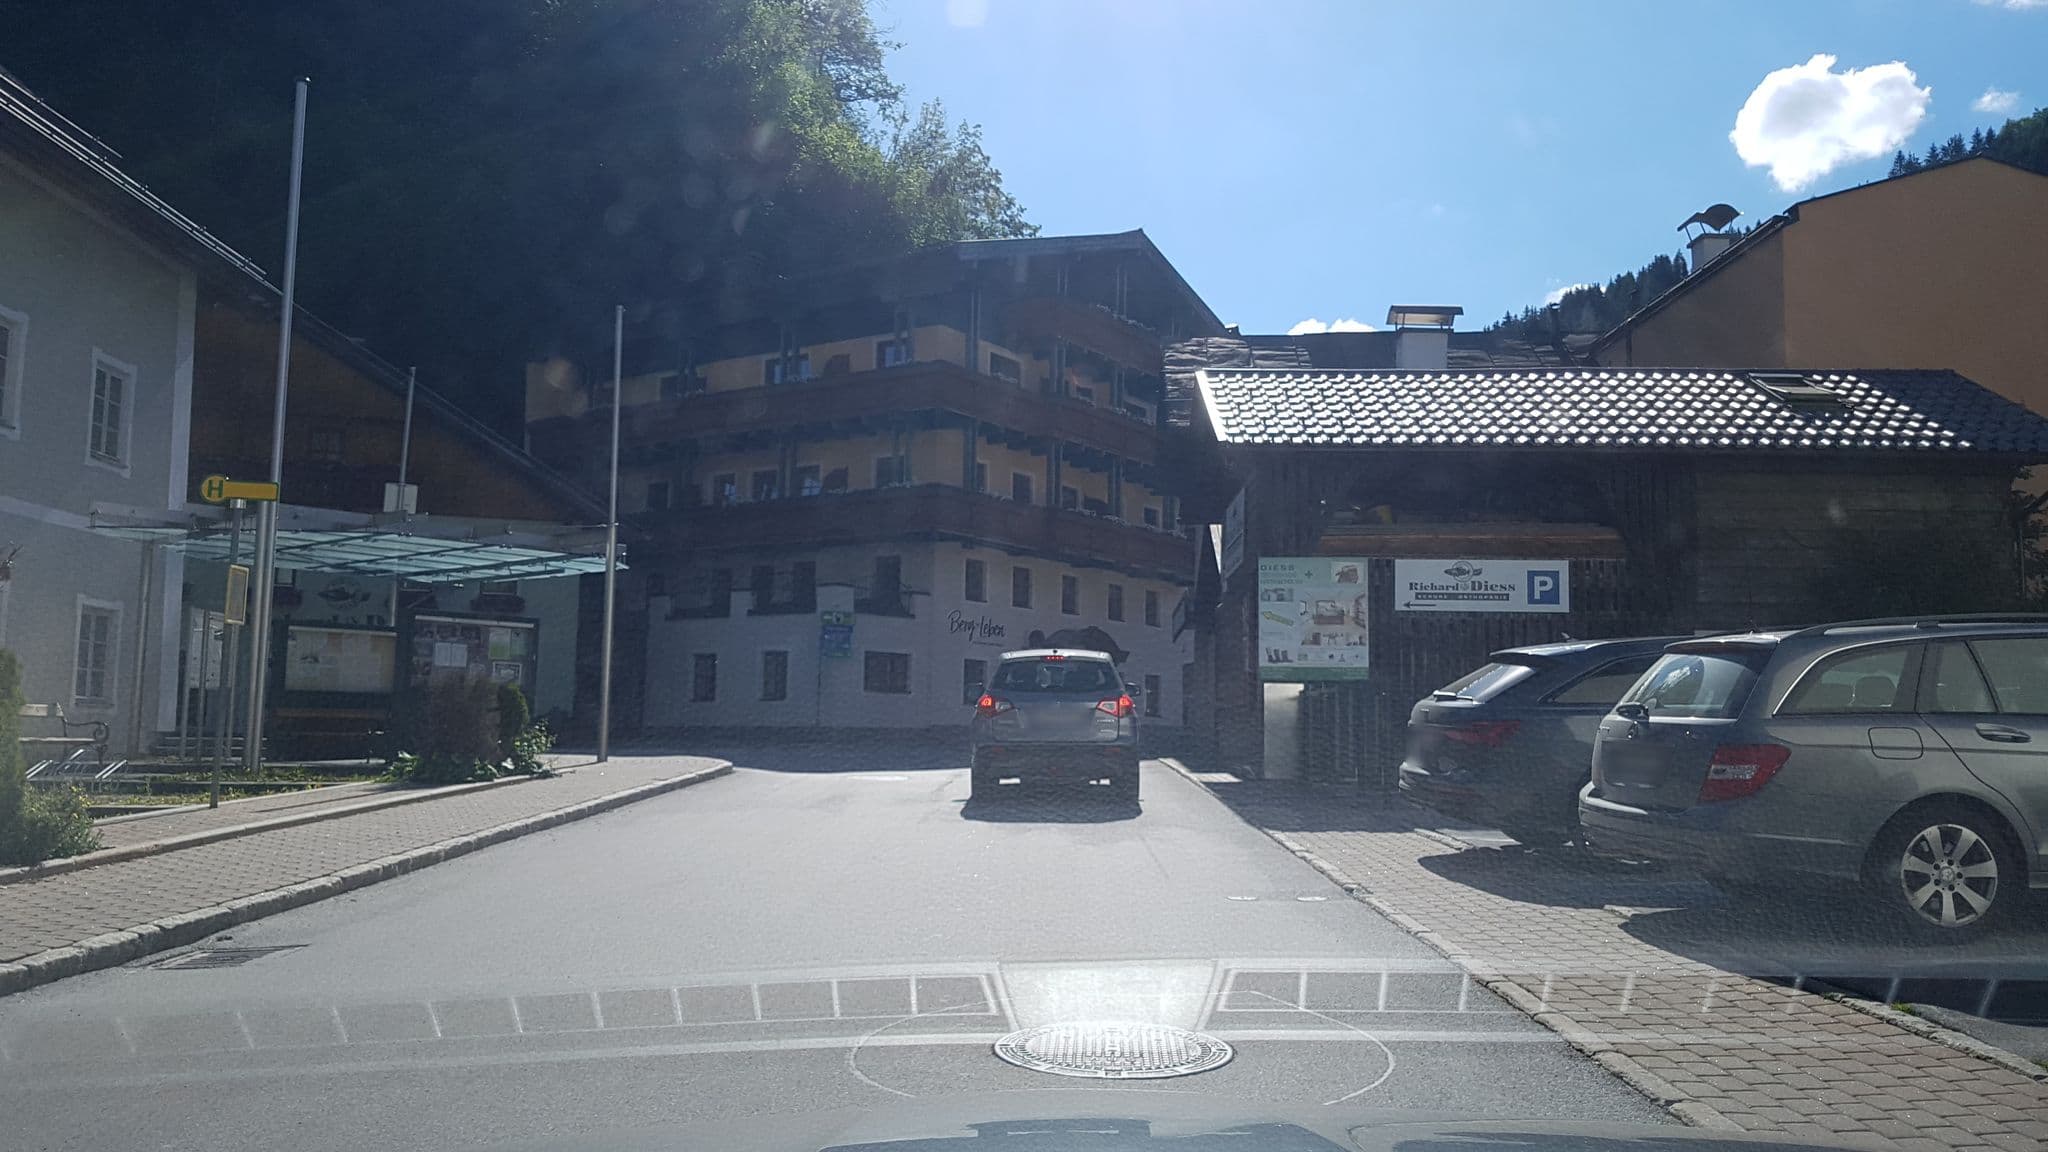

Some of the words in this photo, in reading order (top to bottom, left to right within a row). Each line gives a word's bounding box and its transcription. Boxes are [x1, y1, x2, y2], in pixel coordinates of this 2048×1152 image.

[207, 479, 223, 498] H
[1409, 582, 1459, 591] Richard
[1471, 581, 1515, 591] Diess
[1533, 575, 1553, 600] P
